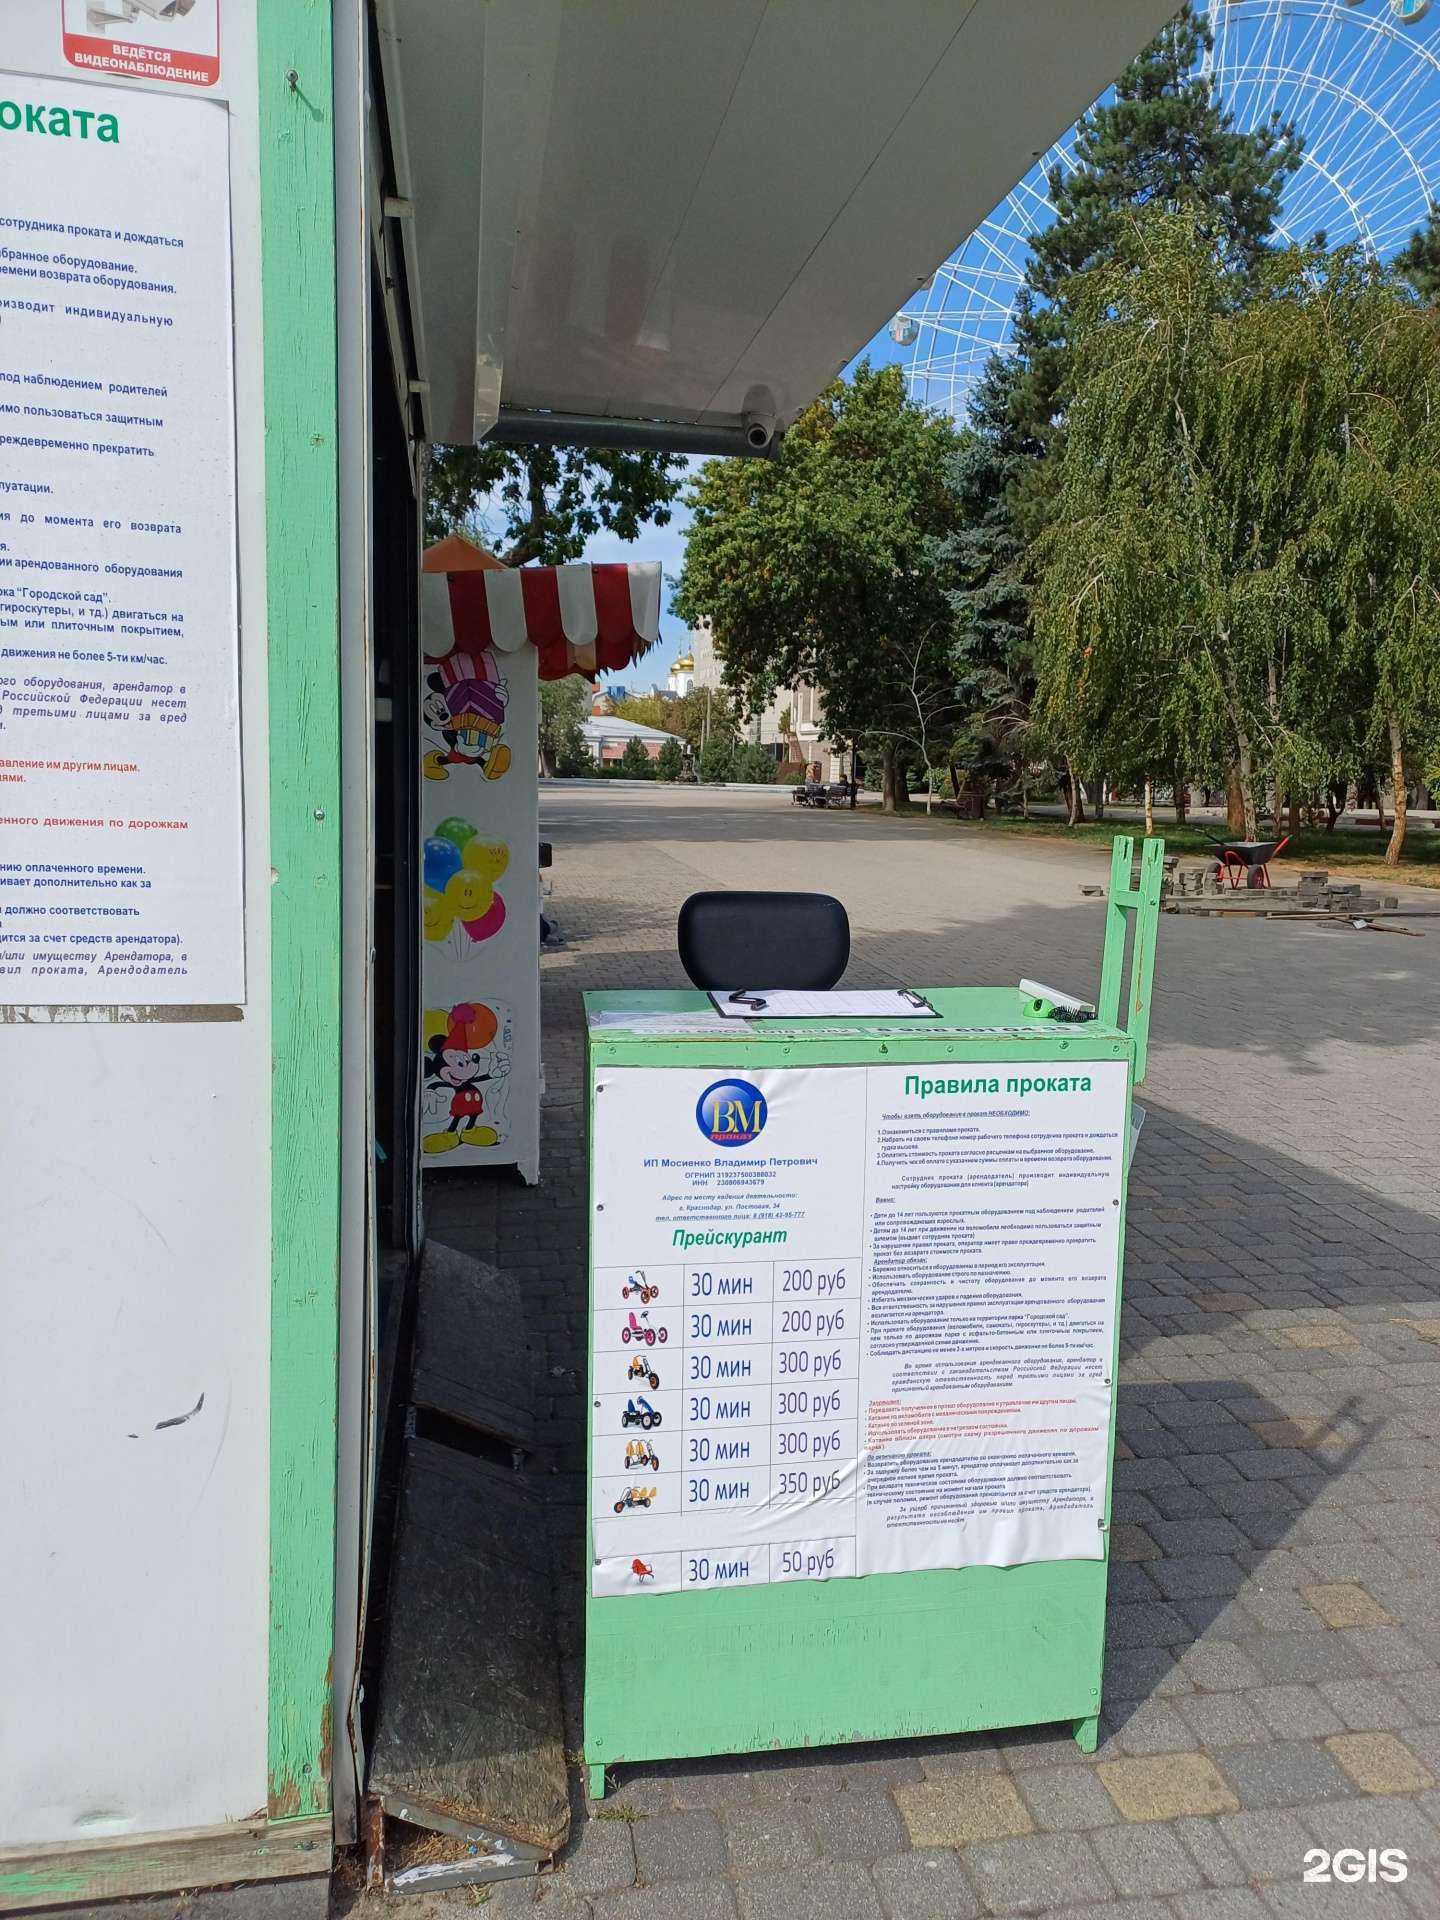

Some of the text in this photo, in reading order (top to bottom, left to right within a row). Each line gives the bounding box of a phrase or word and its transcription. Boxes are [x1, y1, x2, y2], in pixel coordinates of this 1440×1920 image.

[112, 44, 171, 62] ВЕДЁТСЯ
[74, 53, 209, 82] ВИДЕОНАБЛЮДЕНИЕ
[67, 224, 112, 240] проката
[114, 231, 121, 240] и
[124, 231, 184, 248] дождаться
[40, 269, 91, 284] возврата
[65, 306, 173, 327] индивидуальную
[24, 375, 102, 391] наблюдением
[109, 383, 167, 397] родителей
[24, 406, 102, 422] пользоваться
[106, 413, 163, 427] защитным
[21, 514, 34, 523] до
[45, 516, 94, 527] момента
[104, 521, 121, 530] его
[131, 522, 181, 534] возврата
[15, 559, 99, 572] арендованного
[105, 563, 182, 578] оборудования
[112, 610, 167, 621] двигаться
[172, 614, 183, 622] на
[52, 622, 114, 633] плиточным
[1, 648, 55, 659] движения
[73, 650, 104, 661] более
[113, 682, 173, 694] арендатор
[180, 686, 186, 694] в
[3, 690, 70, 703] Российской
[80, 694, 142, 707] Федерации
[86, 711, 129, 721] лицами
[160, 712, 187, 723] вред
[63, 762, 101, 772] другим
[43, 819, 104, 828] движения
[109, 820, 123, 828] по
[128, 820, 188, 829] дорожкам
[25, 864, 93, 874] оплаченного
[34, 879, 117, 888] дополнительно
[121, 880, 137, 888] как
[141, 880, 151, 888] за
[5, 906, 140, 916] должно соответствовать
[29, 935, 40, 943] за
[43, 935, 66, 944] счет
[70, 935, 112, 945] средств
[905, 1075, 1091, 1099] Правила проката
[644, 1158, 817, 1168] ИП Мосиенко Владимир Петрович
[672, 1228, 787, 1249] Прейскурант
[691, 1268, 845, 1297] 30 мин 200 руб
[691, 1309, 844, 1338] 30 мин 200 руб
[690, 1349, 842, 1379] 30 мин 300 руб
[690, 1390, 840, 1421] 30 мин 300 руб
[689, 1430, 840, 1462] 30 мин 300 руб
[689, 1470, 840, 1503] 30 мин 350 руб
[689, 1548, 834, 1582] 30 мин 50 руб
